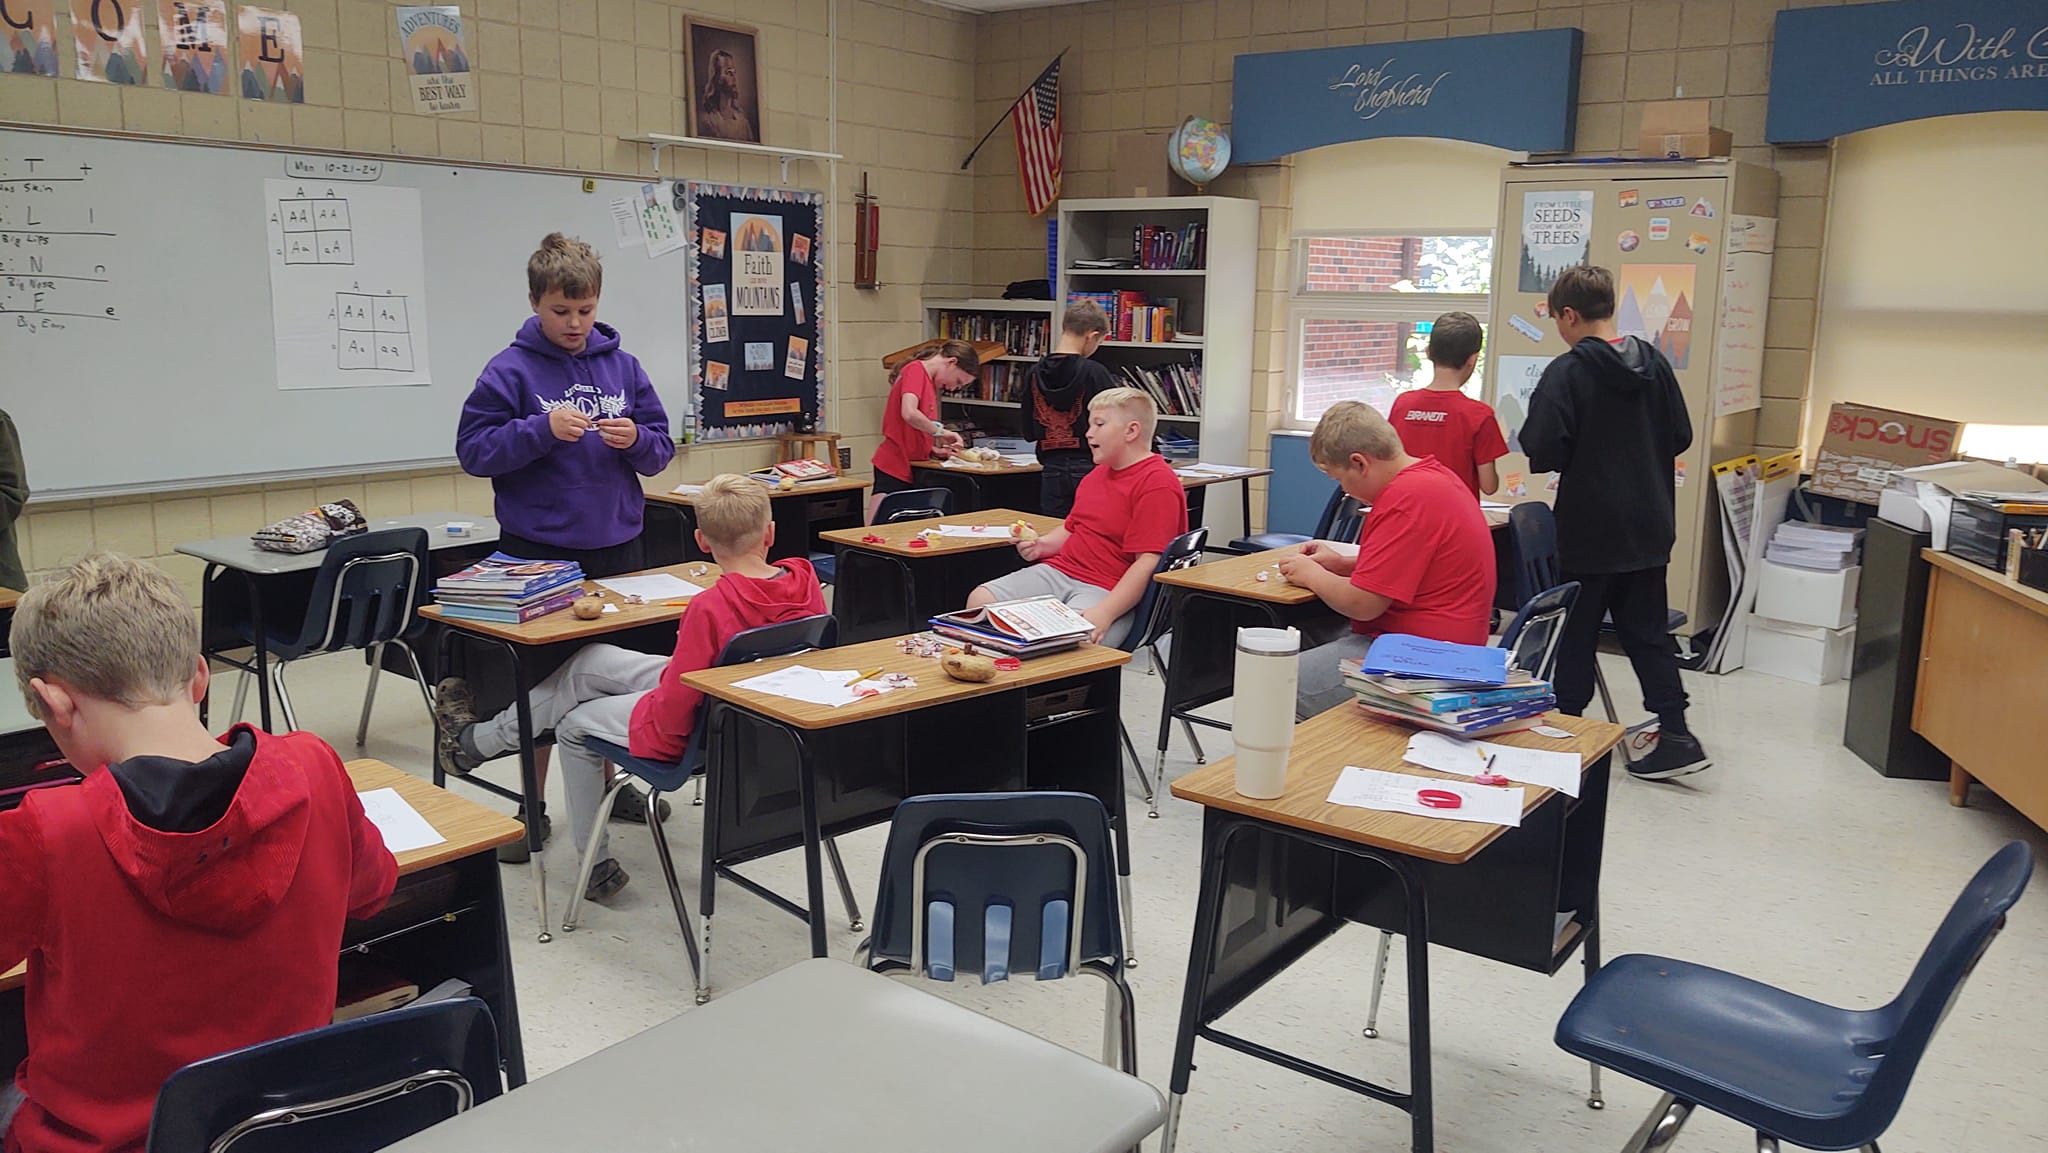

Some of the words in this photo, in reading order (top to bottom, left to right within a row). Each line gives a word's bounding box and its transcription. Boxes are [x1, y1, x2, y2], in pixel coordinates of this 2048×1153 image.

[401, 11, 460, 38] ADVENTURES
[1874, 23, 2016, 68] With
[1328, 58, 1397, 90] Lord
[1869, 71, 1908, 86] ALL
[1915, 66, 1997, 84] THINGS
[2004, 64, 2048, 79] ARE
[419, 86, 442, 101] BEST
[444, 84, 466, 99] WAY
[1534, 208, 1581, 223] SEEDS
[1532, 230, 1580, 245] TREES
[744, 253, 773, 275] Faith
[736, 286, 780, 309] MOUNTAINS
[1404, 410, 1448, 422] BRANDT
[1839, 414, 1953, 453] snack
